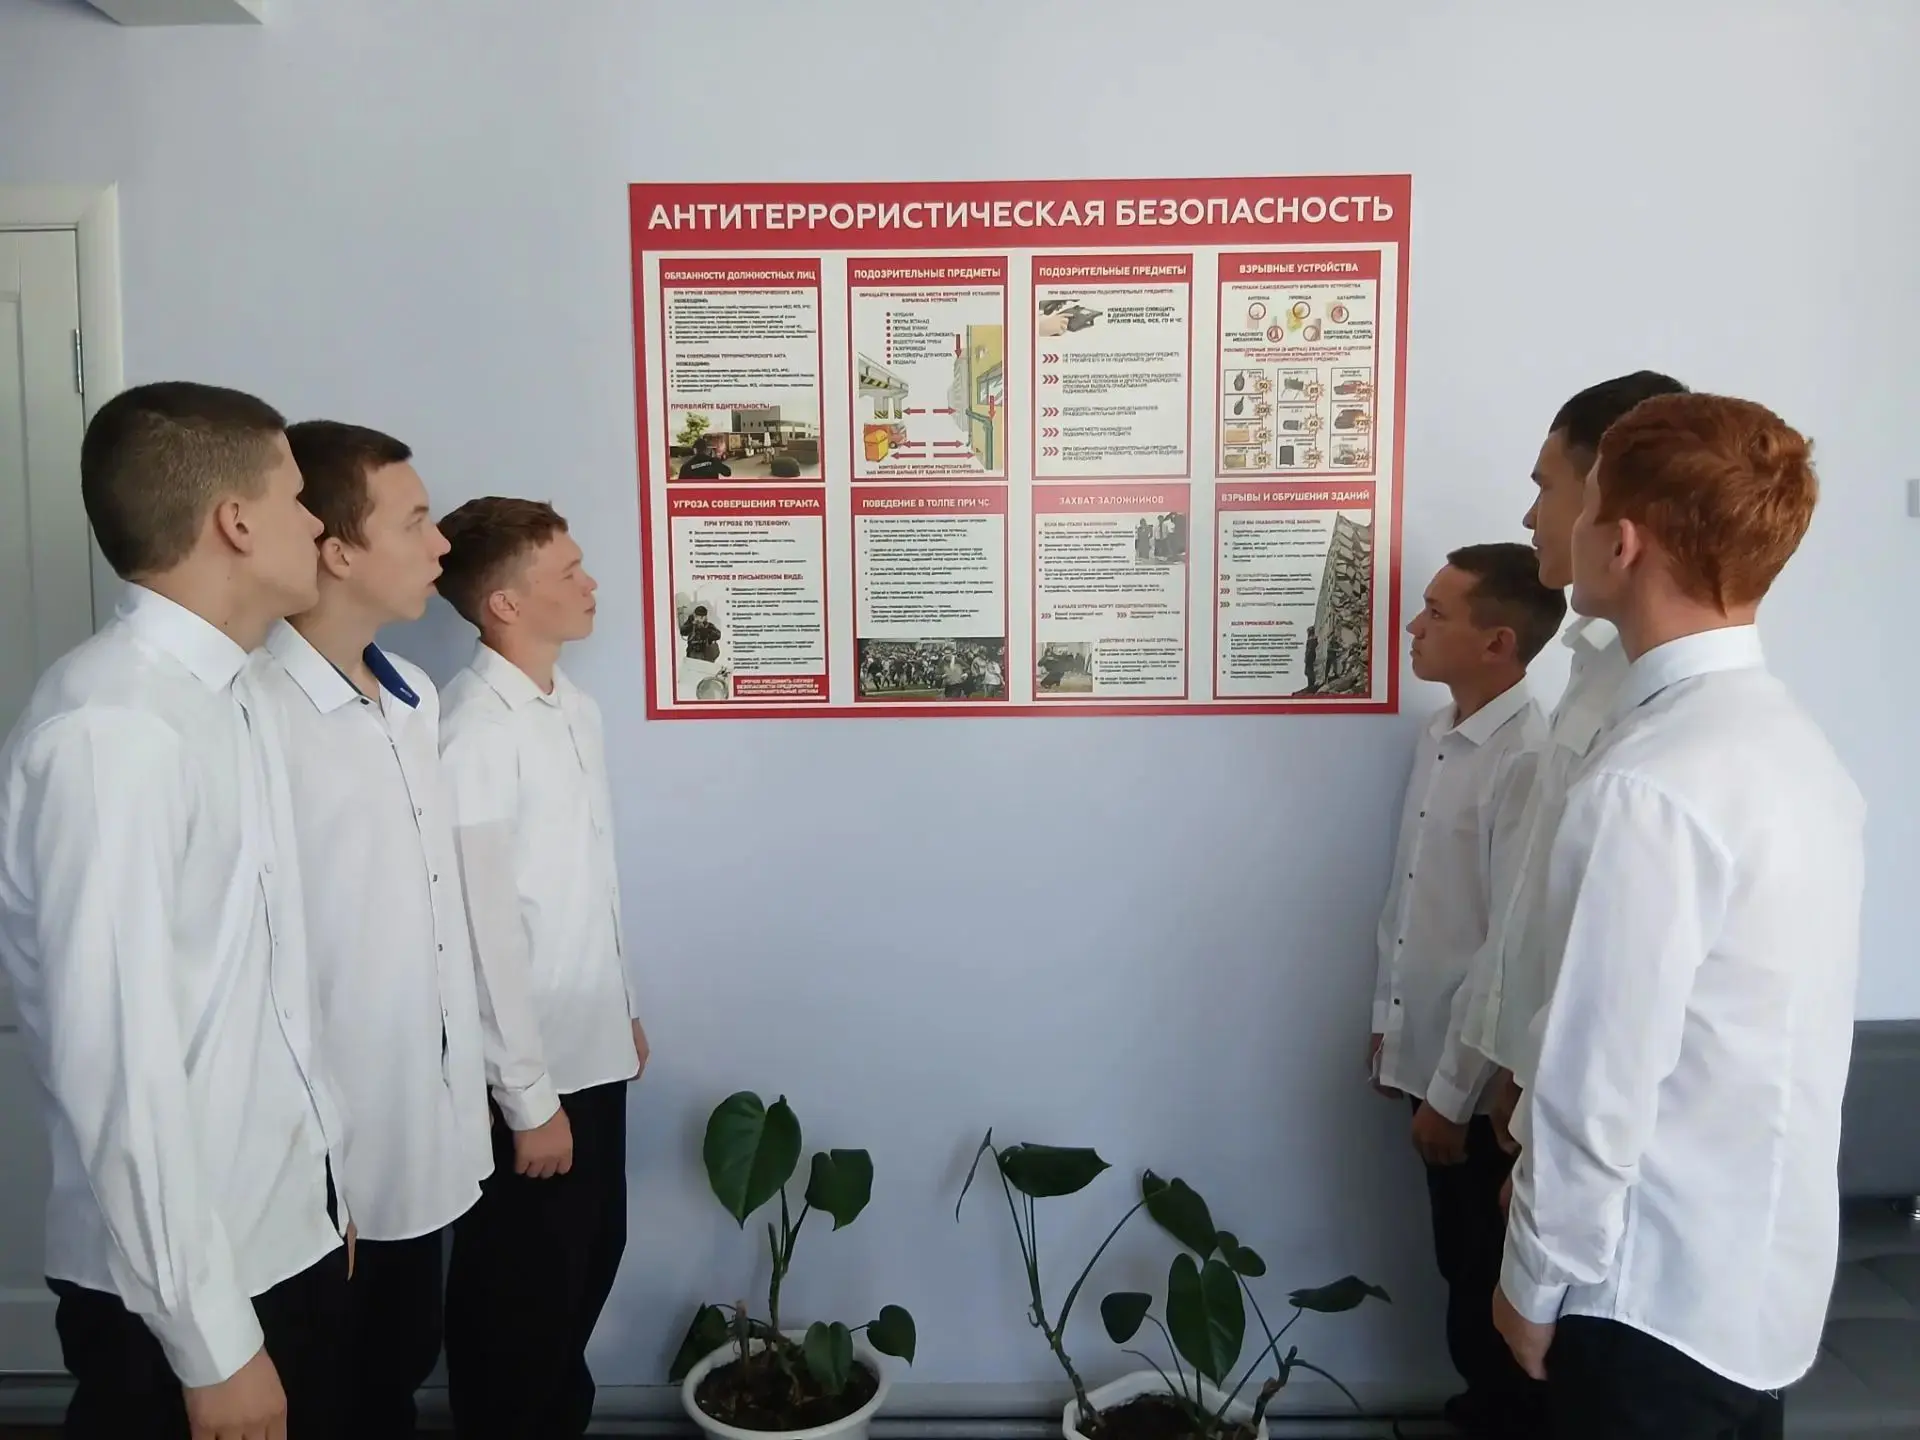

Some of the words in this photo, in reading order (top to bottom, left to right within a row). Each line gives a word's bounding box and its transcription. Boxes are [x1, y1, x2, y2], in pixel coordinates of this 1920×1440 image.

[648, 200, 1106, 228] АНТИТЕРРОРИСТИЧЕСКАЯ
[1115, 197, 1394, 224] БЕЗОПАСНОСТЬ
[855, 269, 945, 278] ПОДОЗРИТЕЛЬНЫЕ
[948, 268, 1001, 278] ПРЕДМЕТЫ
[1040, 267, 1130, 277] ПОДОЗРИТЕЛЬНЫЕ
[1133, 266, 1186, 276] ПРЕДМЕТЫ
[1240, 264, 1294, 273] ВЗРЫВНЫЕ
[1297, 263, 1359, 272] УСТРОЙСТВА
[1222, 492, 1261, 501] ВЗРЫВЫ
[1263, 492, 1270, 500] И
[1273, 491, 1329, 500] ОБРУШЕНИЯ
[1331, 490, 1369, 500] ЗДАНИЙ
[673, 500, 710, 508] УГРОЗА
[712, 500, 776, 508] СОВЕРШЕНИЯ
[778, 499, 820, 508] ТЕРАКТА
[862, 499, 916, 508] ПОВЕДЕНИЕ
[918, 499, 924, 508] В
[926, 499, 955, 508] ТОЛПЕ
[957, 498, 975, 507] ПРИ
[978, 498, 989, 507] ЧС
